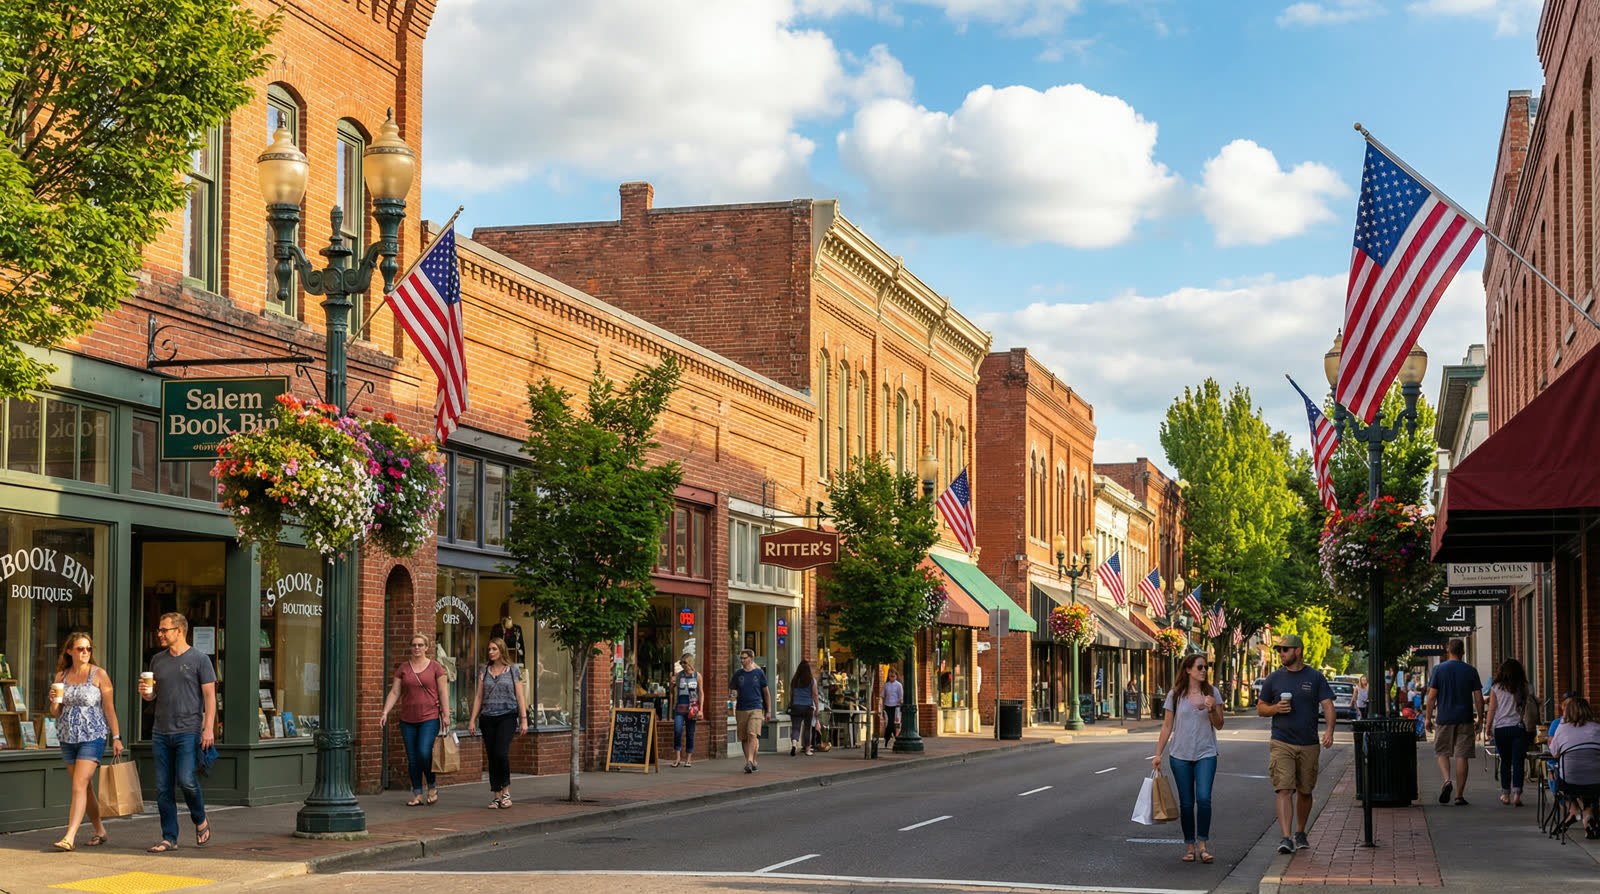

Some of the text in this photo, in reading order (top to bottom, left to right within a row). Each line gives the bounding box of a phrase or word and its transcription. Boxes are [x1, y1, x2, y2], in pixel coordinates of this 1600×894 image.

[186, 388, 263, 410] Salem
[169, 413, 280, 435] Book Bin
[765, 541, 832, 557] RITTER'S
[0, 547, 95, 595] BOOK BIN
[11, 584, 73, 603] BOUTIQUES
[276, 572, 312, 598] BOOK
[283, 602, 323, 617] BOUTIQUES
